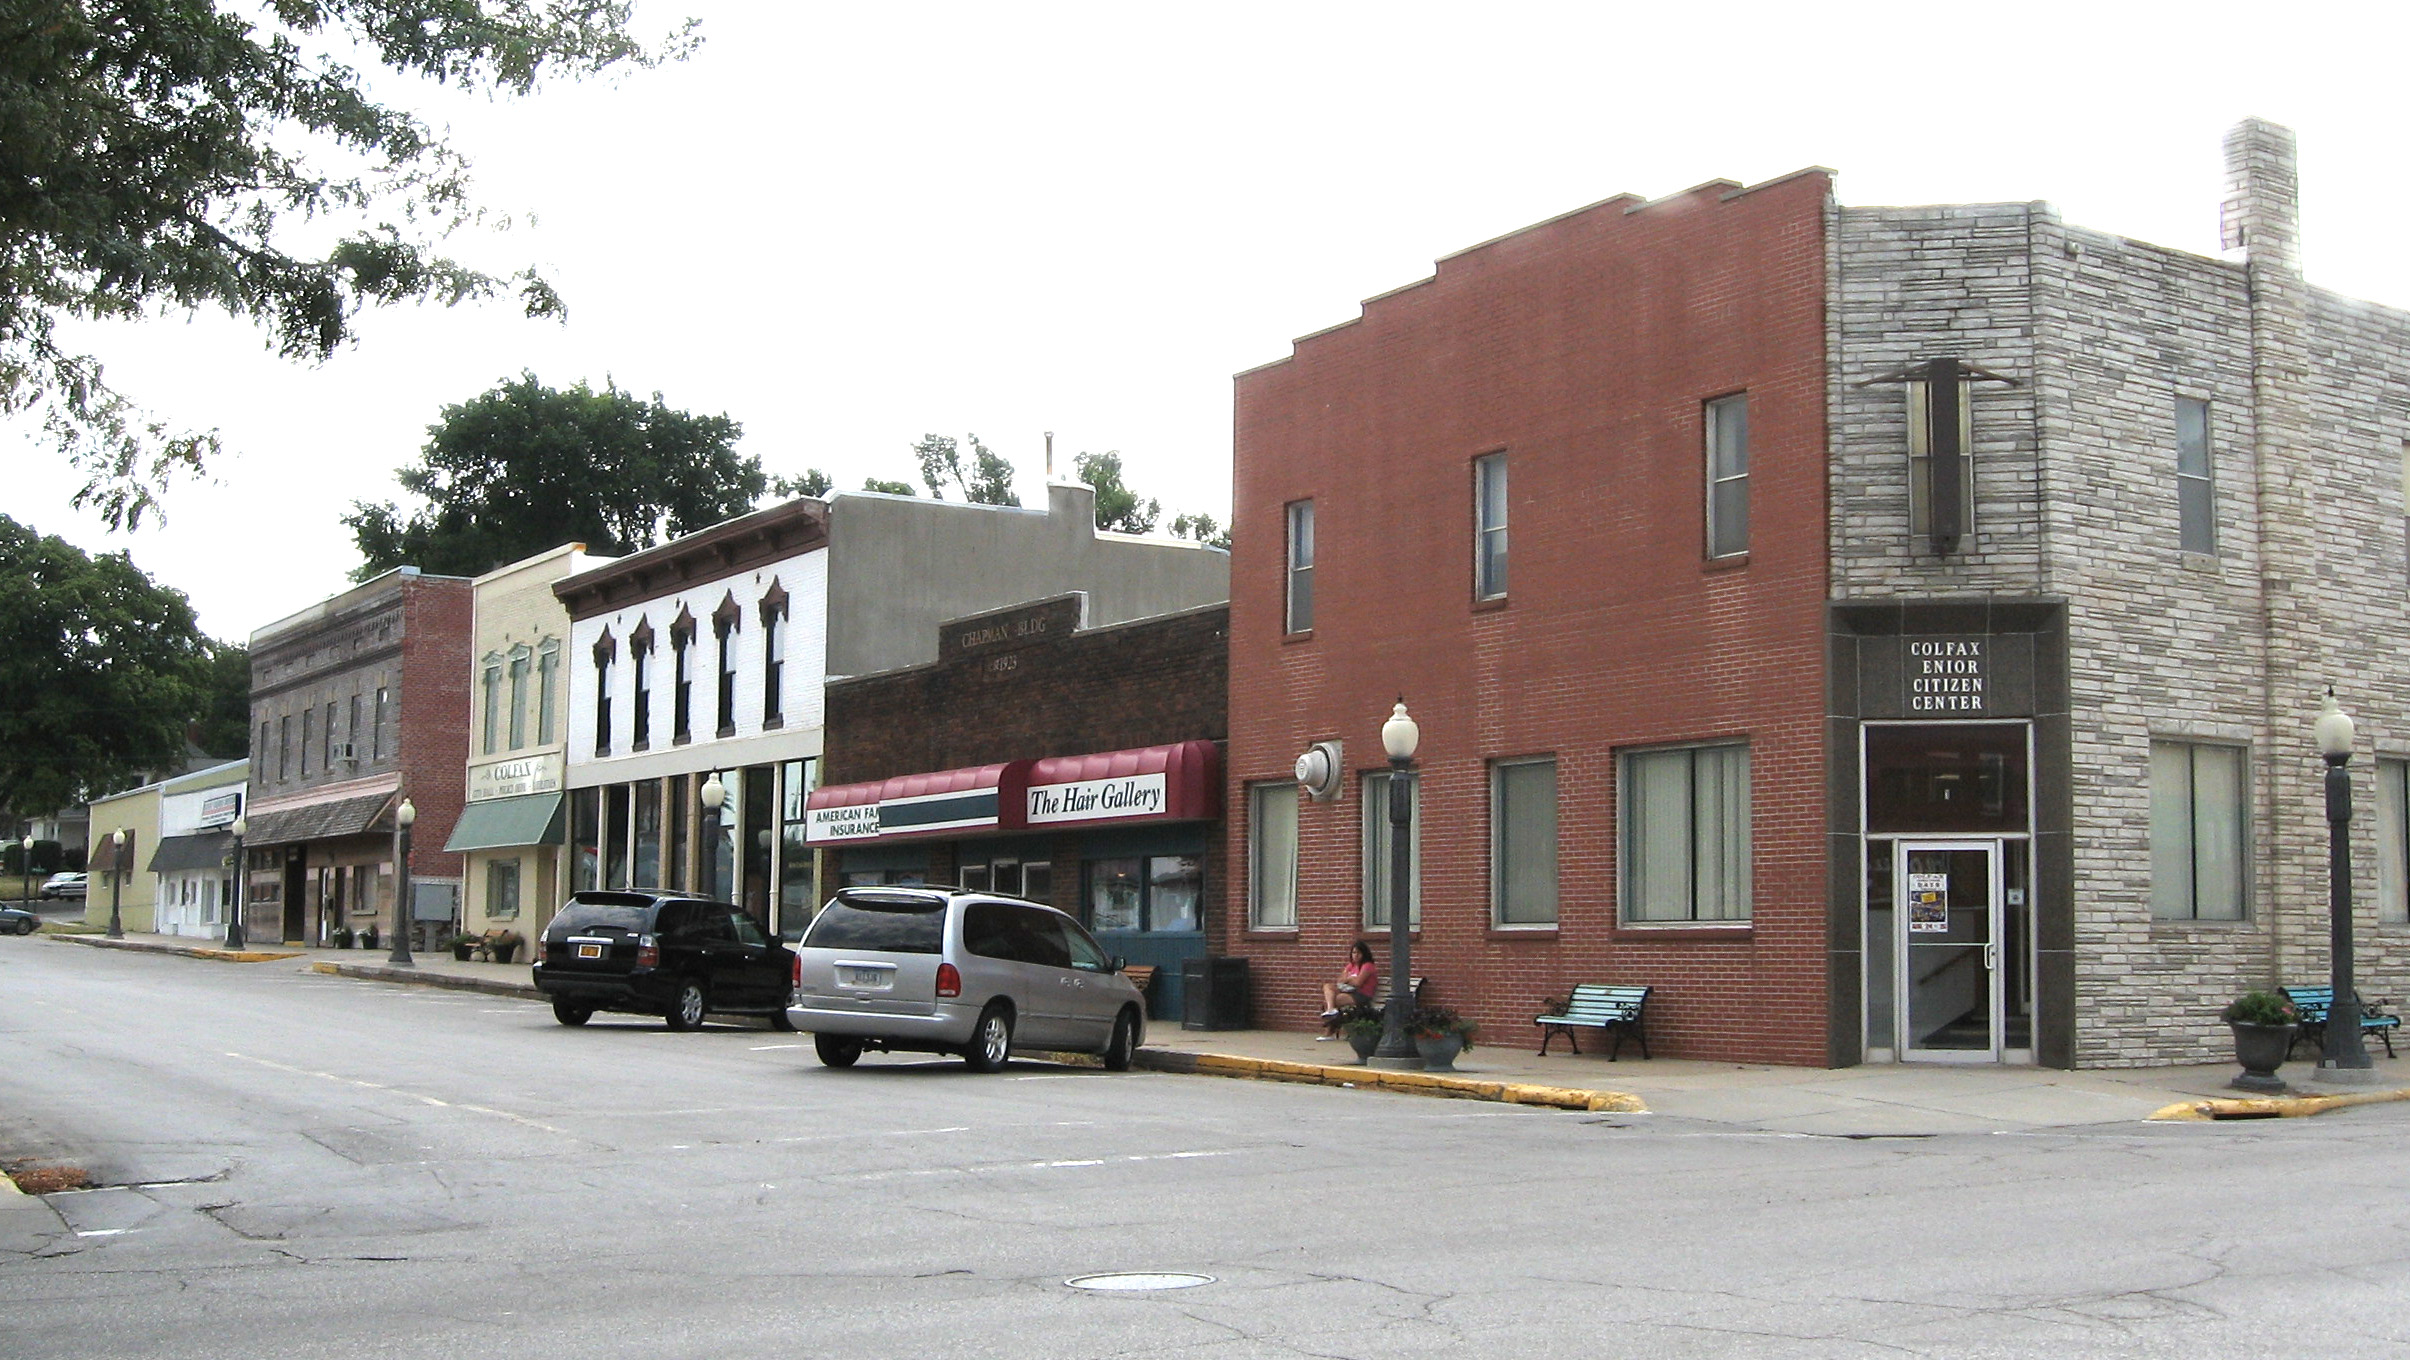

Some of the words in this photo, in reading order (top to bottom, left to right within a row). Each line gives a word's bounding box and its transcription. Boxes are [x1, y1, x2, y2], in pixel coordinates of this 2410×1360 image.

[962, 624, 1009, 648] CHAPMAN
[1017, 616, 1046, 637] BLDG
[1911, 641, 1980, 656] COLFAX
[1922, 660, 1978, 674] ENIOR
[1913, 678, 1982, 693] CITIZEN
[1912, 695, 1982, 710] CENTER
[494, 762, 532, 780] COLFAX
[1031, 790, 1059, 815] The
[1062, 787, 1099, 813] Hair
[1101, 781, 1160, 812] Gallery
[815, 807, 862, 824] AMERICAN
[829, 821, 880, 837] INSURANCE
